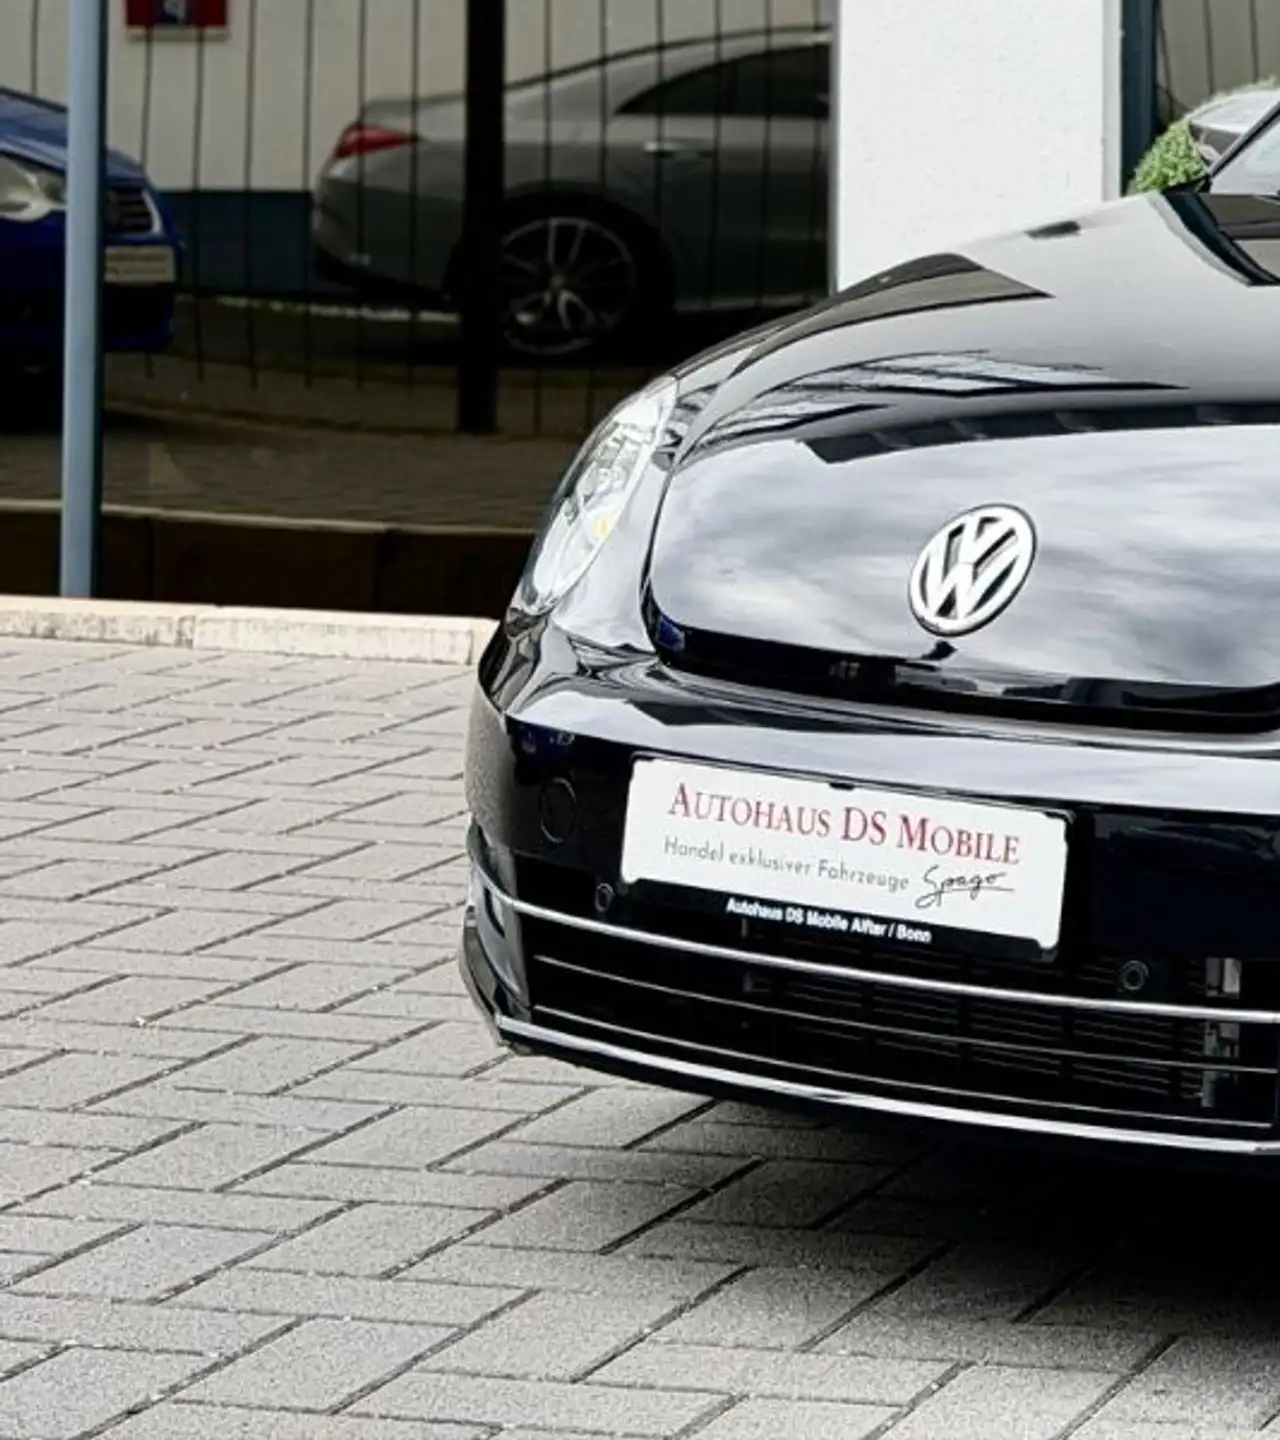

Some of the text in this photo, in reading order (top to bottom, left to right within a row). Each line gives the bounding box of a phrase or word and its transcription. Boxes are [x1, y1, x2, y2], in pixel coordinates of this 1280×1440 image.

[667, 782, 1020, 865] AUTOHAUS DS MOBILE
[663, 835, 909, 893] Handel exklusiver Fahrzeuge
[726, 896, 783, 922] Autohaus
[785, 906, 804, 925] DS
[806, 909, 849, 932] Mobile
[897, 923, 932, 945] Bonn
